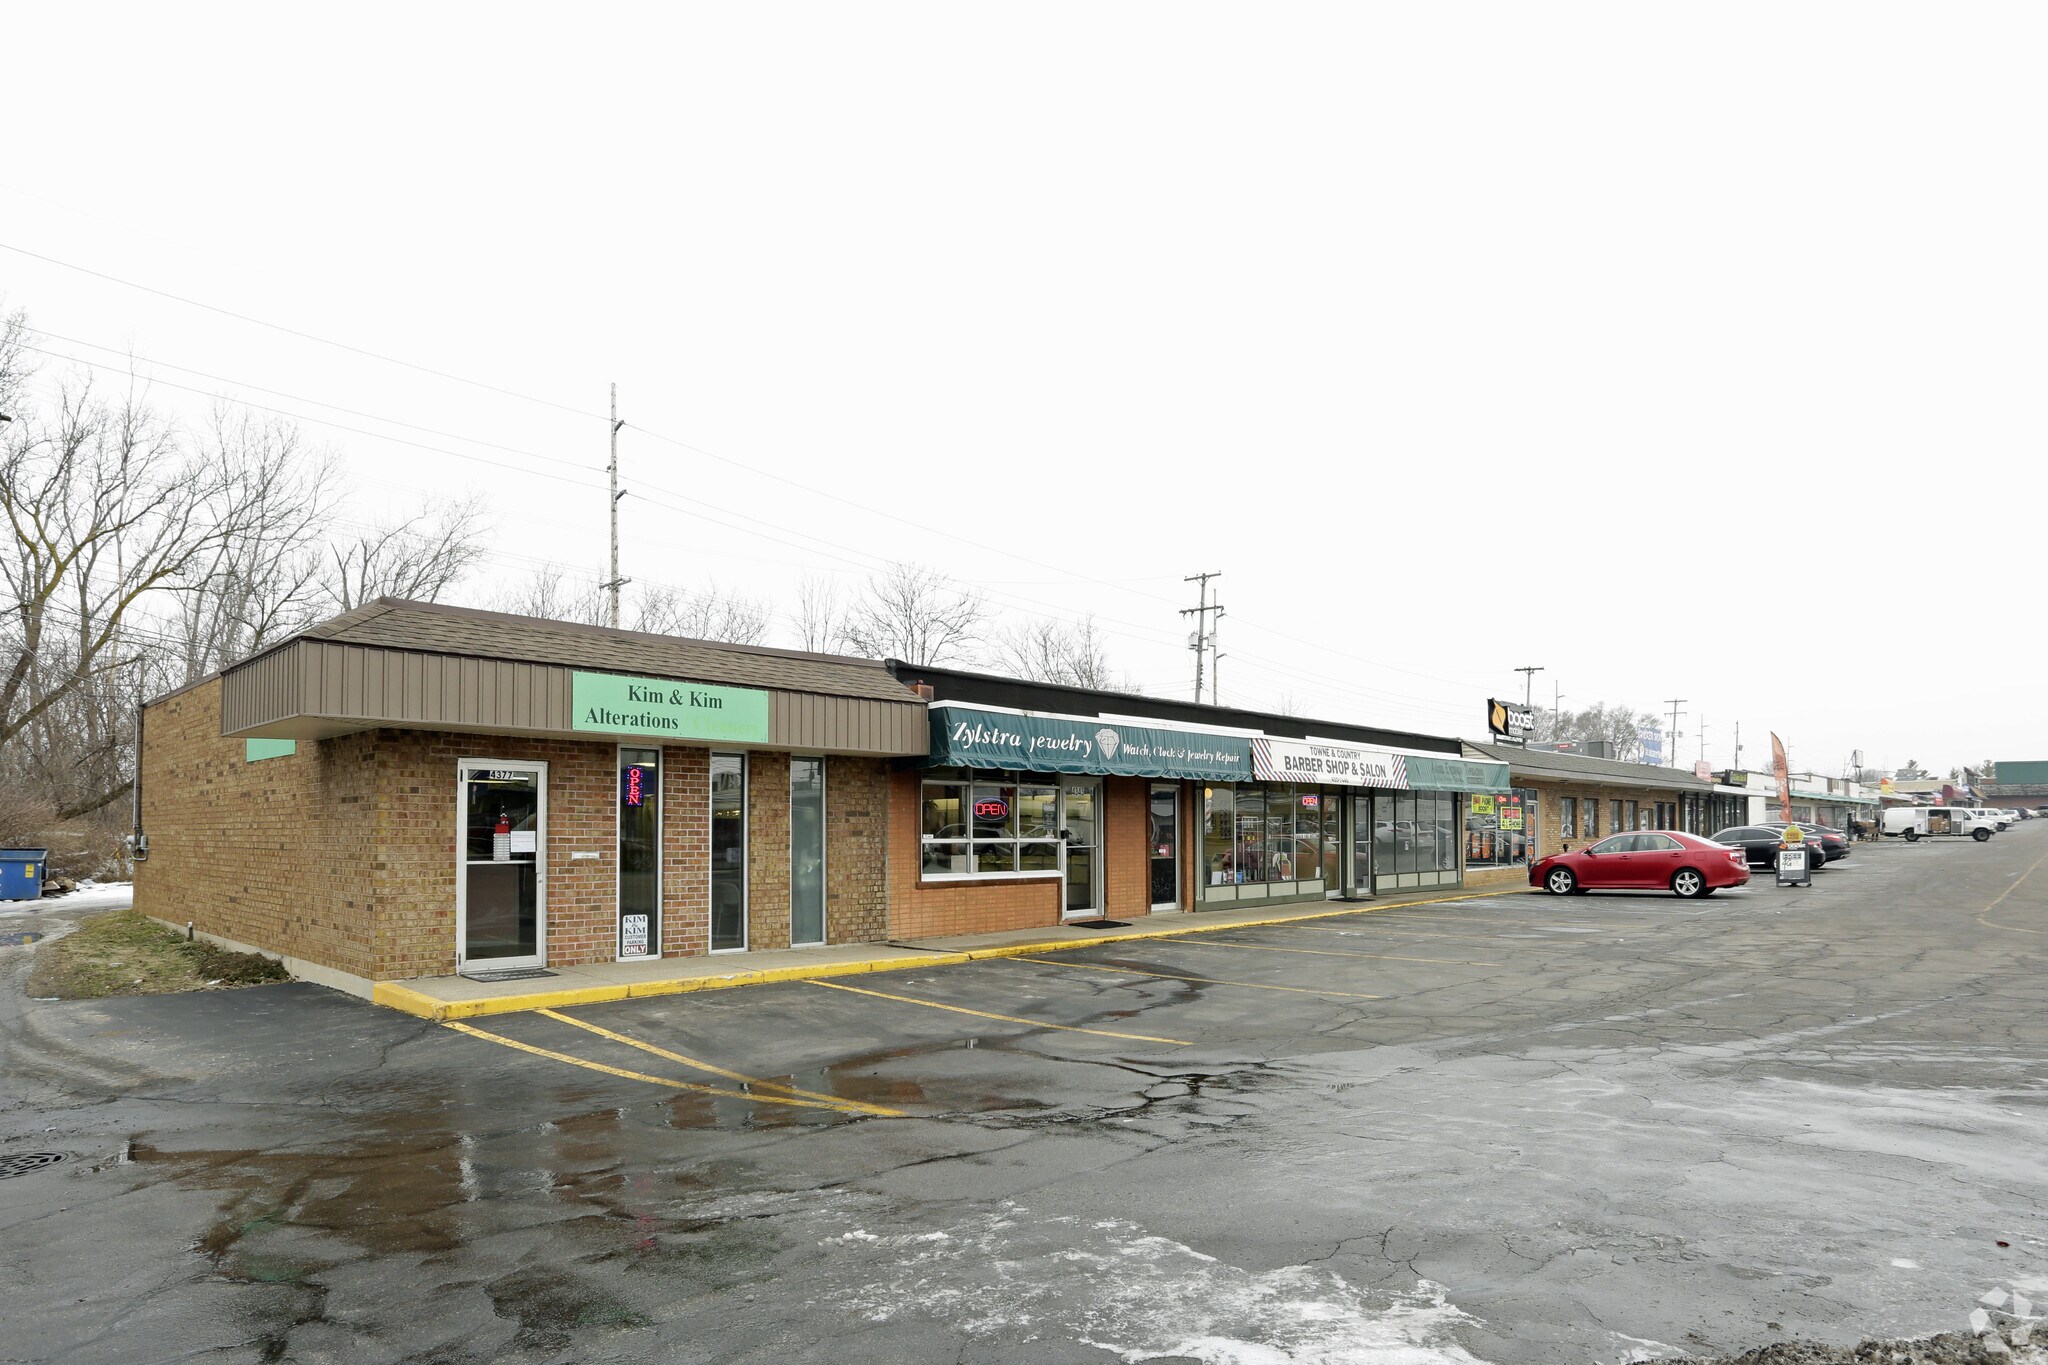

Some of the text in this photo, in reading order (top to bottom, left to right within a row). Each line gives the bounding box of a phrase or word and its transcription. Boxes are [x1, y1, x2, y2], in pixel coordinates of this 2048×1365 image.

[628, 685, 723, 709] Kim & Kim
[585, 707, 679, 730] Alterations
[1507, 706, 1534, 729] boost
[953, 722, 1022, 749] Zylstra
[1187, 749, 1214, 764] Jewelry
[1215, 751, 1240, 765] Repair
[1310, 747, 1361, 760] TOWNE & COUNTRY
[1284, 756, 1387, 778] BARBER SHOP & SALON
[489, 770, 513, 780] 4377
[629, 768, 641, 804] OPEN
[1303, 797, 1317, 805] OPEN
[975, 803, 1006, 815] OPEN
[625, 915, 646, 924] KIM
[625, 927, 646, 935] KIM
[625, 945, 646, 954] ONLY
